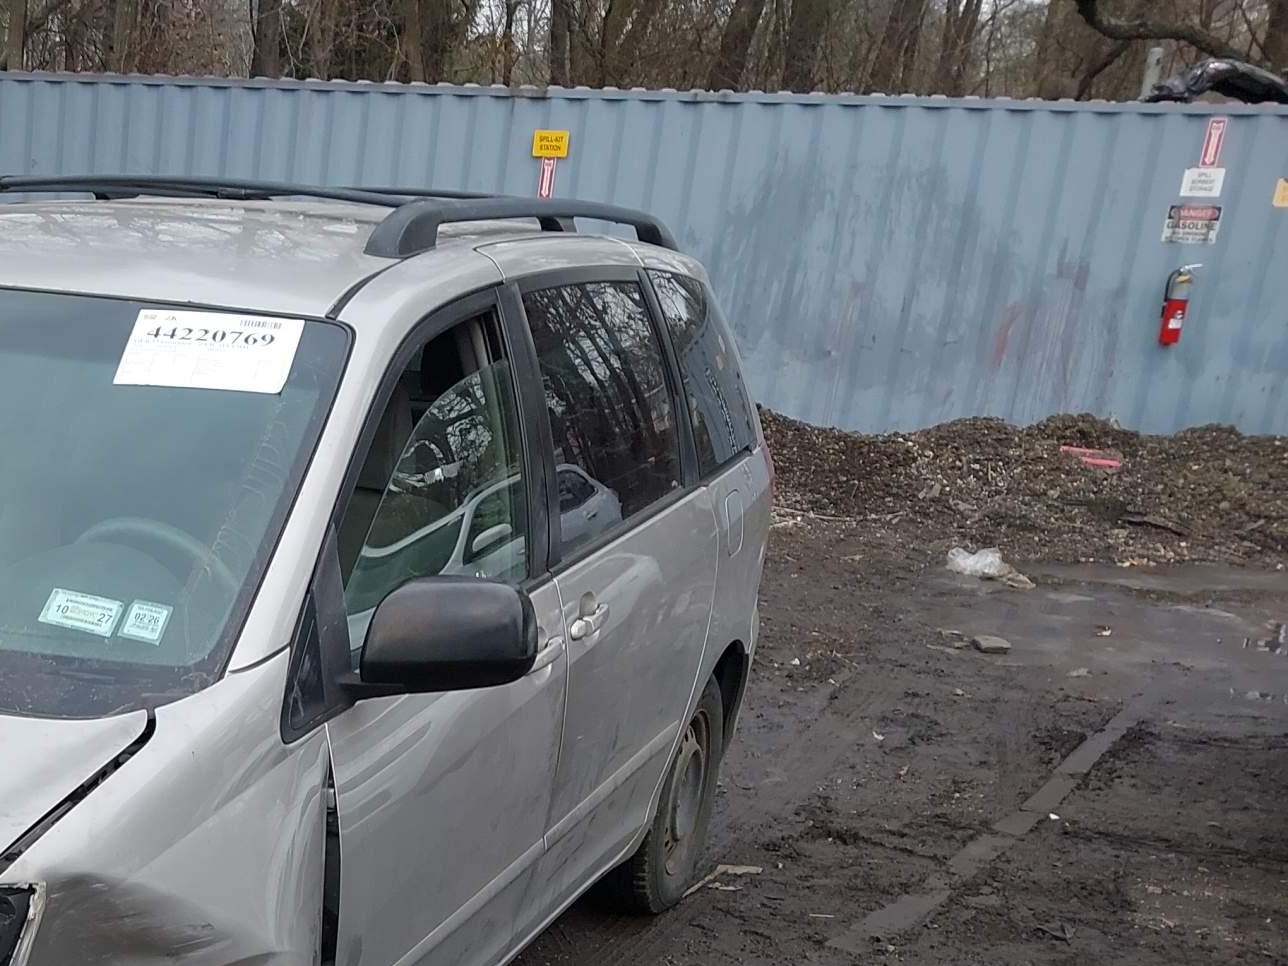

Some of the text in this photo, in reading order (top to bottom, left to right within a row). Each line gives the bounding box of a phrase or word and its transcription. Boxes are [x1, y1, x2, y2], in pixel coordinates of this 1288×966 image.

[1167, 222, 1216, 230] GASOLINE
[146, 325, 276, 346] 44220769
[56, 603, 70, 614] 10
[97, 613, 113, 624] 27
